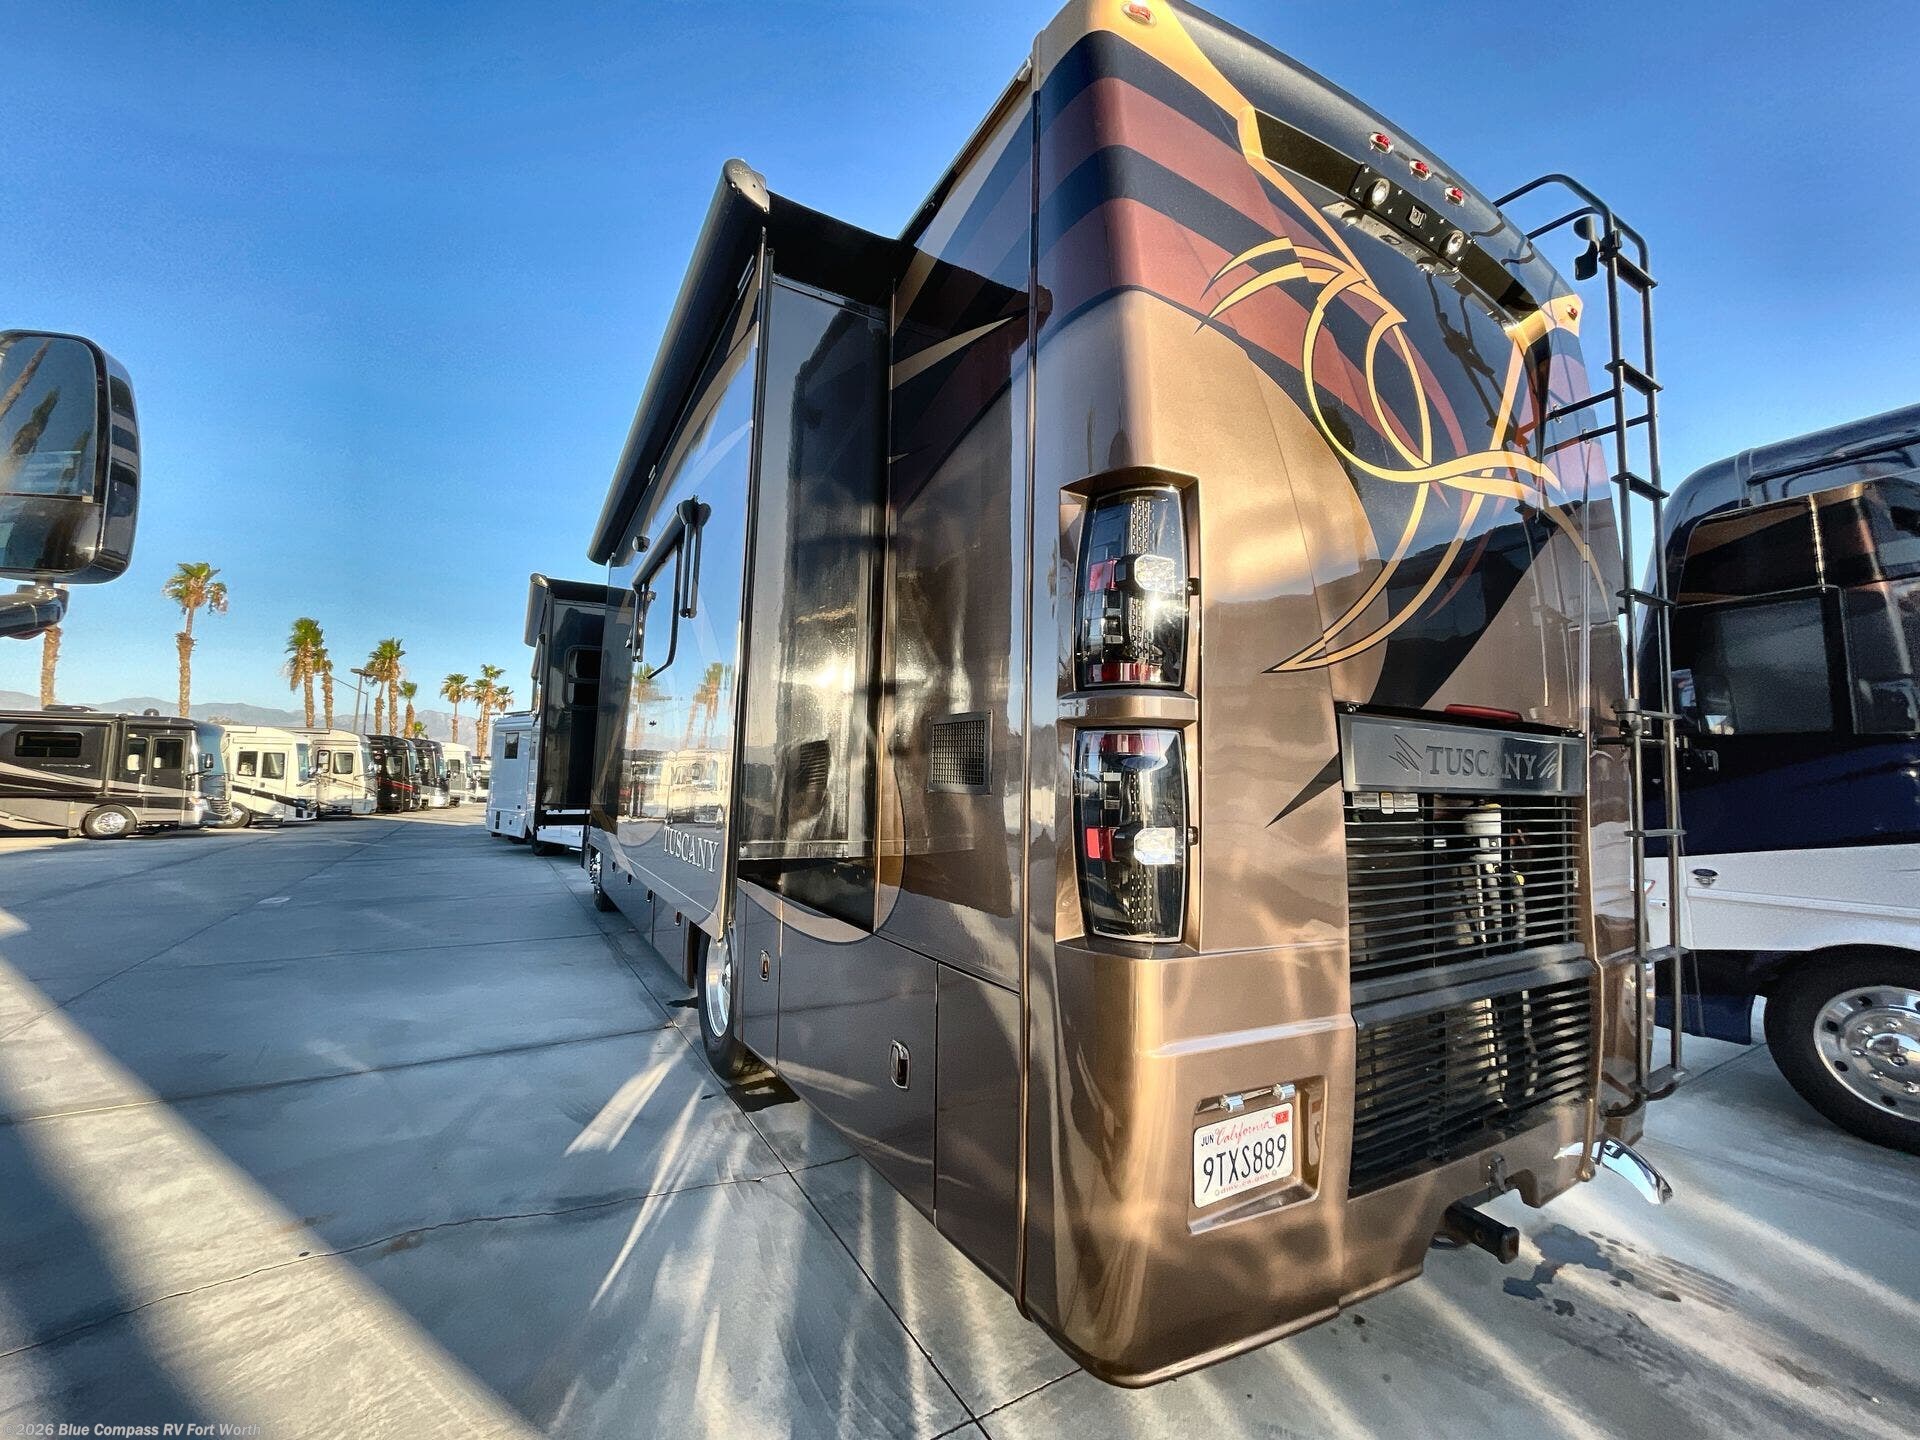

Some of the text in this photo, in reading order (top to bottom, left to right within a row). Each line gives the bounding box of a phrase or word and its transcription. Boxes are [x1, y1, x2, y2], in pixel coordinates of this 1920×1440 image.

[1425, 745, 1537, 781] TUSCANY
[663, 826, 719, 873] TUSCANY
[1201, 1120, 1274, 1147] JUN California
[1203, 1134, 1287, 1194] 9TXS889
